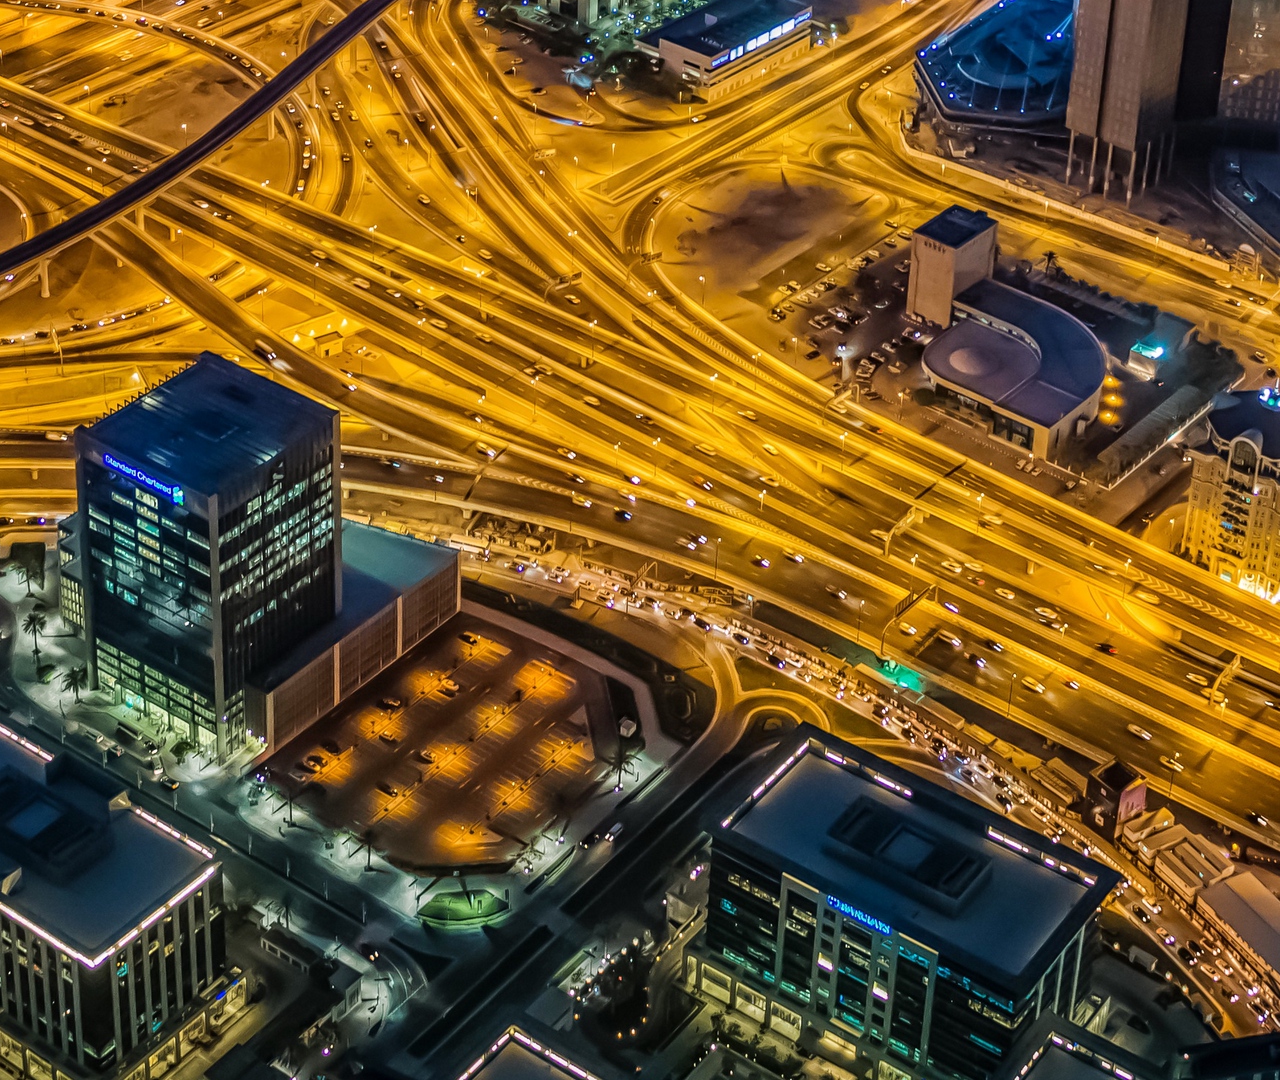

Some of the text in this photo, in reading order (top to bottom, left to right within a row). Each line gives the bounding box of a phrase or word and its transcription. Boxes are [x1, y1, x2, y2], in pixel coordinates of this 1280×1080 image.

[105, 454, 171, 495] Standard Chartered
[840, 903, 890, 934] BARCLAYS
